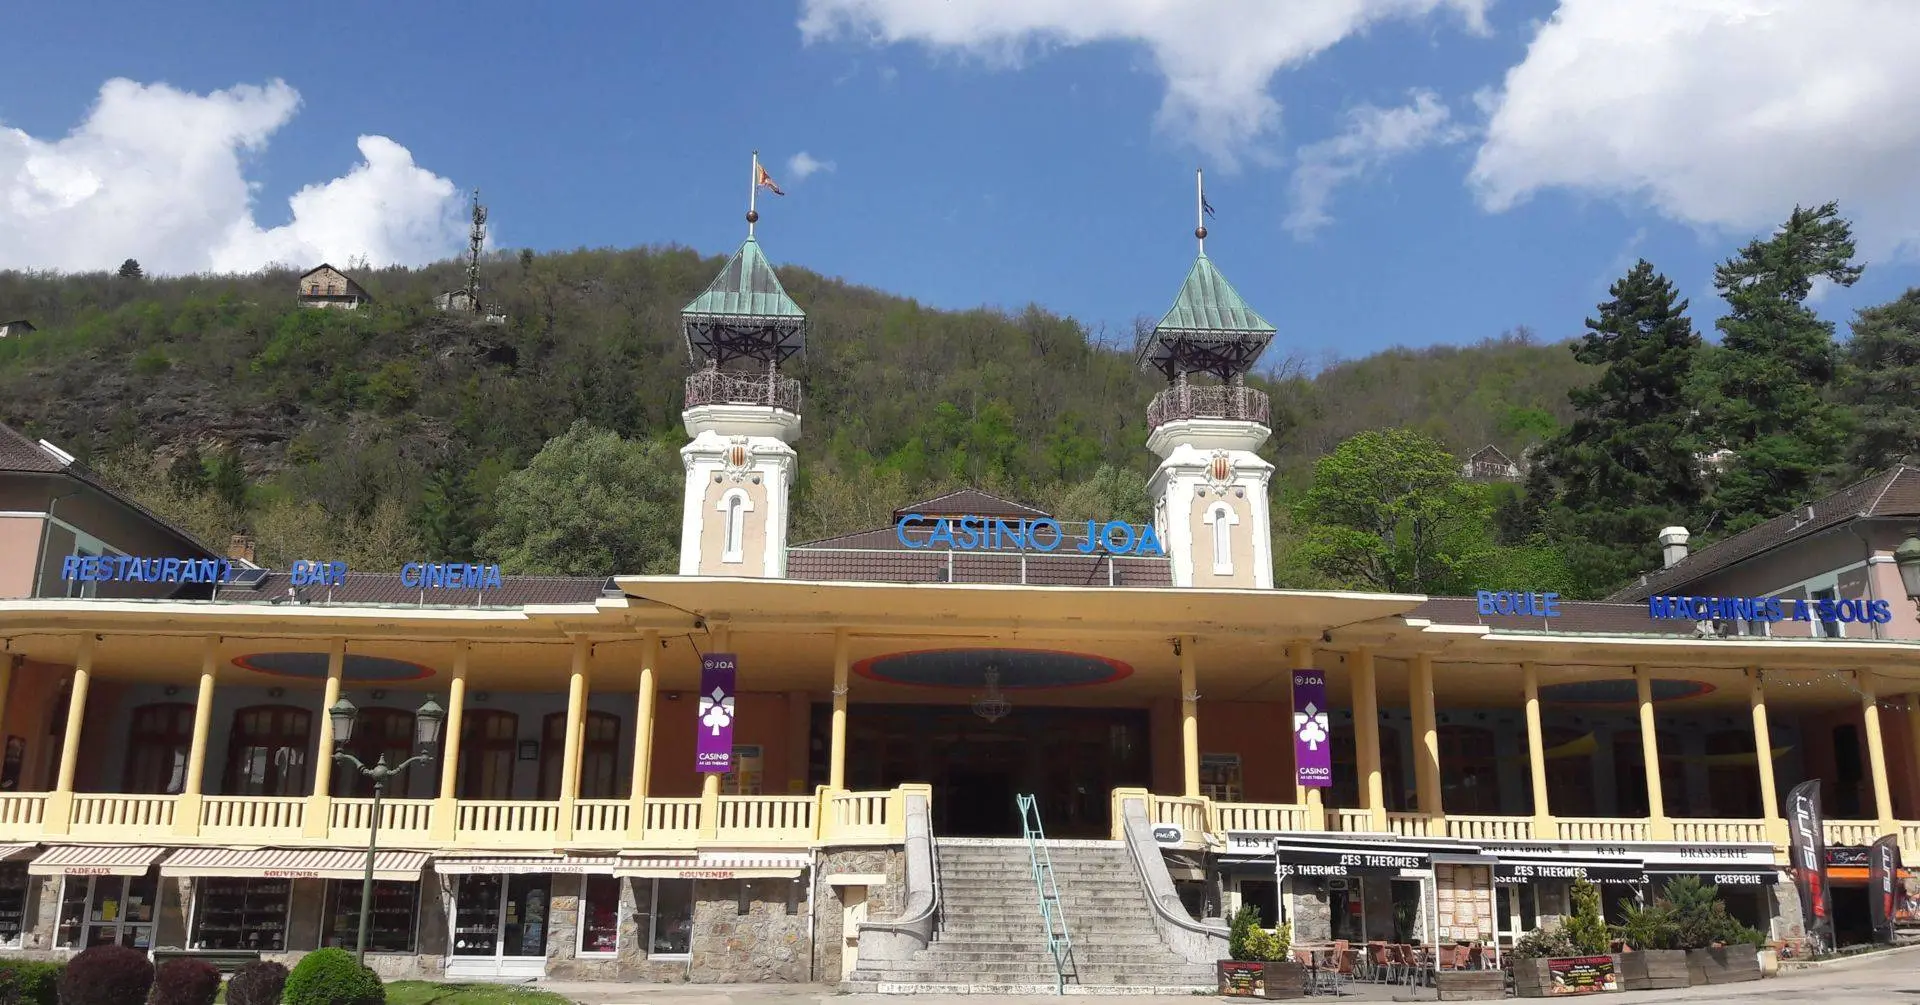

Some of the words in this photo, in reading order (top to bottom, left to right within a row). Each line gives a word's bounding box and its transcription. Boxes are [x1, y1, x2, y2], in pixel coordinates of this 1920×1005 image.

[897, 513, 1063, 551] CASINO
[1077, 519, 1166, 556] JOA
[61, 555, 234, 584] RESTAURANT
[291, 559, 347, 586] BAR
[401, 561, 503, 590] CINEMA
[1477, 589, 1562, 617] BOULE
[1649, 595, 1785, 623] MACHINES
[1792, 599, 1811, 622] A
[1818, 599, 1892, 624] SOUS
[714, 661, 734, 669] JOA
[1304, 677, 1324, 685] JOA
[699, 753, 729, 761] CASINO
[1300, 767, 1329, 775] CASINO
[1237, 837, 1260, 848] LES
[1597, 847, 1626, 856] BAR
[1680, 848, 1748, 859] BRASSERIE
[1340, 855, 1361, 866] LES
[1365, 855, 1419, 868] THERMES
[64, 867, 111, 875] CADEAUX
[1298, 865, 1347, 875] THERMES
[1515, 865, 1534, 876] LES
[1537, 866, 1588, 878] THERMES
[1715, 875, 1762, 885] CREPERIE
